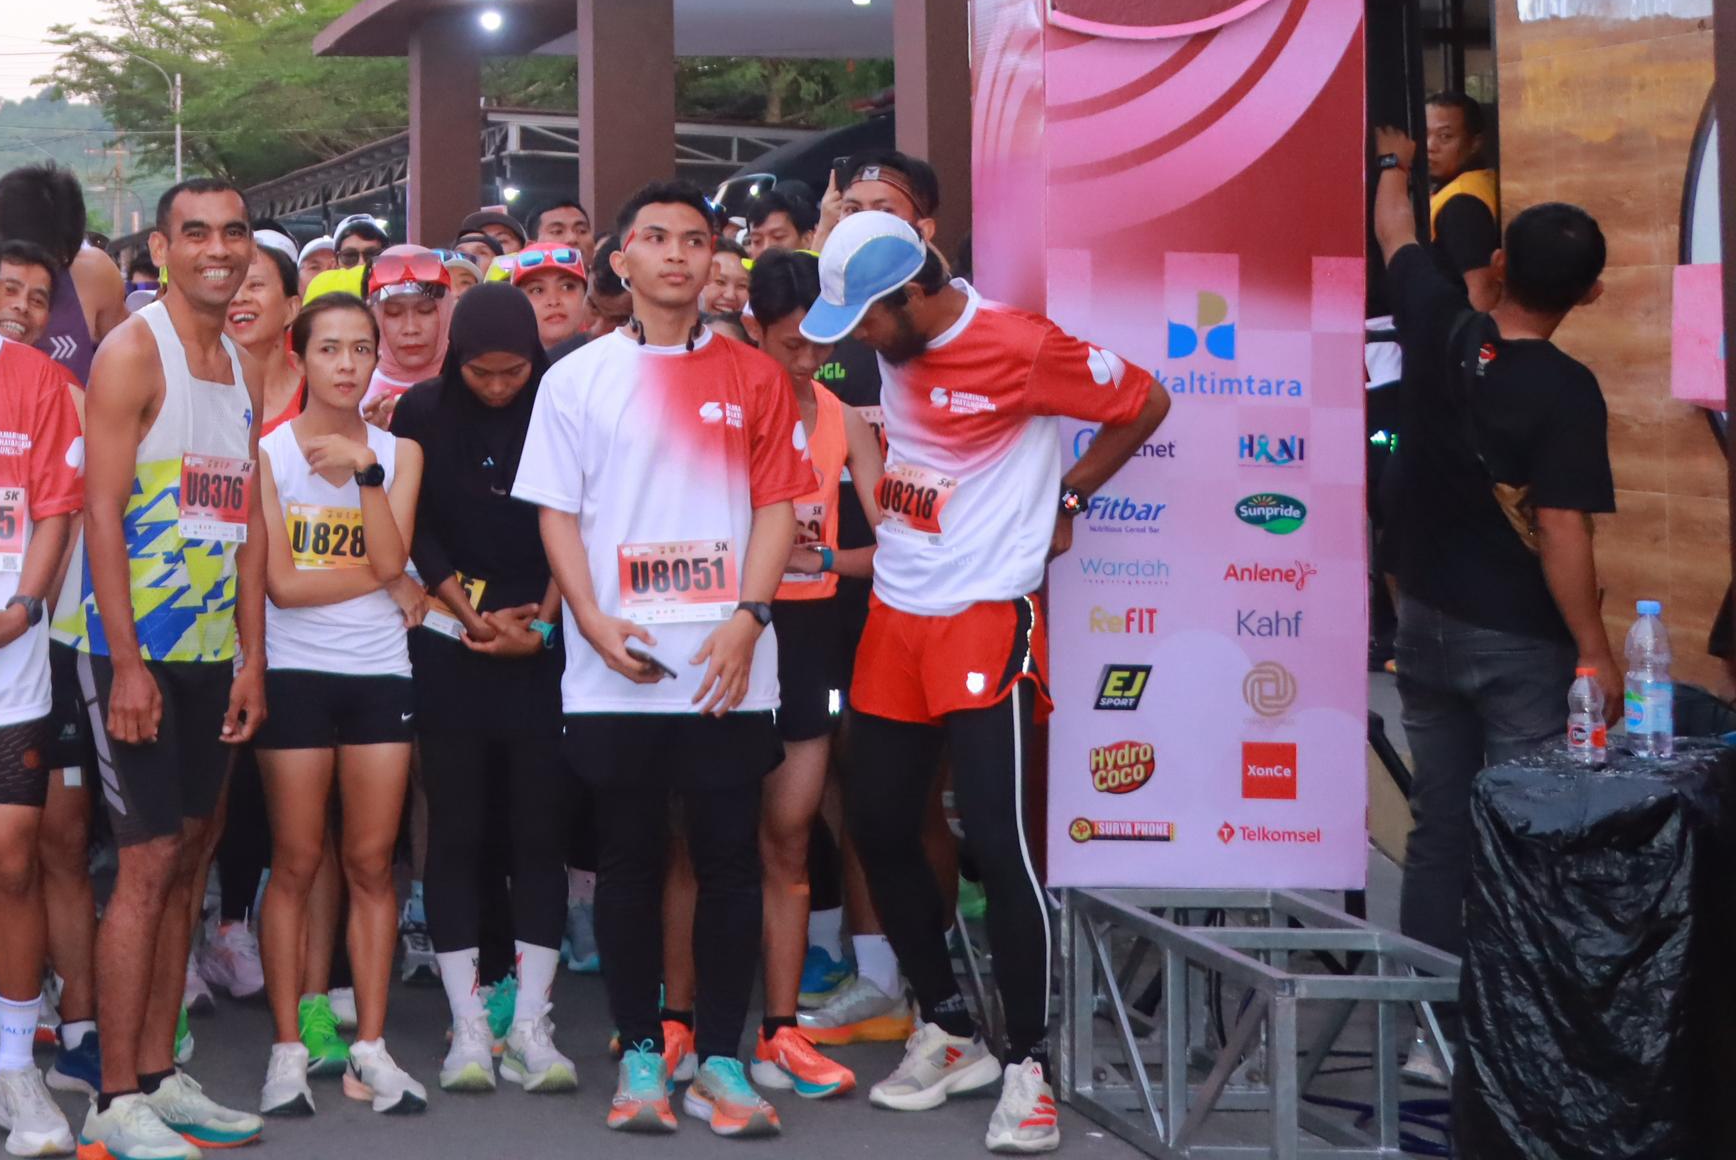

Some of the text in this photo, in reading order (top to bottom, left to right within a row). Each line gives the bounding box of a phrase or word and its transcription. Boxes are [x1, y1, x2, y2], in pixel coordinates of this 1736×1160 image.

[1155, 370, 1303, 397] kaltimtara
[4, 490, 19, 501] 5K
[186, 471, 244, 511] U8376
[881, 476, 938, 521] U8218
[1086, 496, 1166, 521] Fitbar
[1239, 504, 1302, 520] Sunpride
[292, 520, 367, 558] U828
[715, 541, 729, 552] 5K
[630, 556, 726, 594] U8051
[1224, 562, 1297, 583] Anlene
[1236, 609, 1304, 638] Kahf
[1103, 671, 1147, 697] EJ
[1099, 697, 1135, 707] SPORT
[1090, 742, 1154, 772] Hydro
[1247, 764, 1292, 777] XonCe
[1098, 821, 1132, 835] SURYA
[1133, 822, 1170, 835] PHONE
[1239, 826, 1321, 843] Telkomsel
